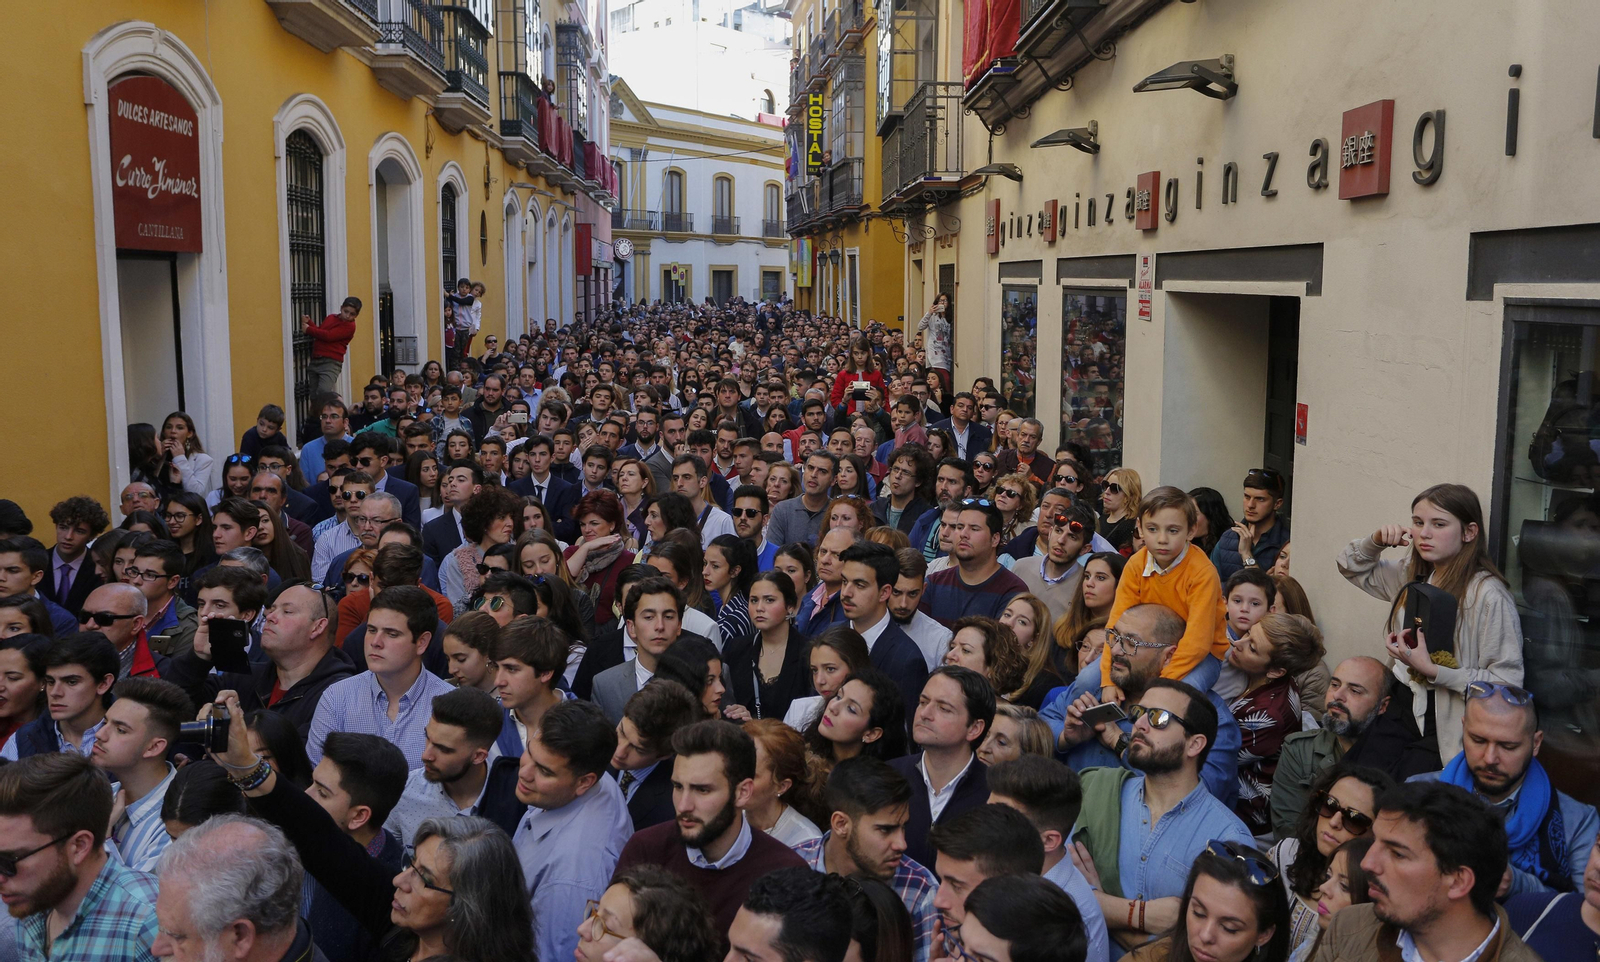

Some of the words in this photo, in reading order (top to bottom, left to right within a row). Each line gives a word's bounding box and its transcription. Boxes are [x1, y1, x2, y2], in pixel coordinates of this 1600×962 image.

[117, 98, 149, 125] DULCES
[149, 109, 194, 138] ARTESANOS
[808, 93, 823, 166] HOSTAL
[1000, 210, 1044, 248] ginza
[1059, 187, 1136, 237] ginza
[1165, 138, 1329, 222] ginza
[1412, 64, 1600, 185] gi
[1341, 130, 1375, 169] 銀座
[116, 154, 153, 188] Curro
[138, 222, 184, 240] CANTILLANA
